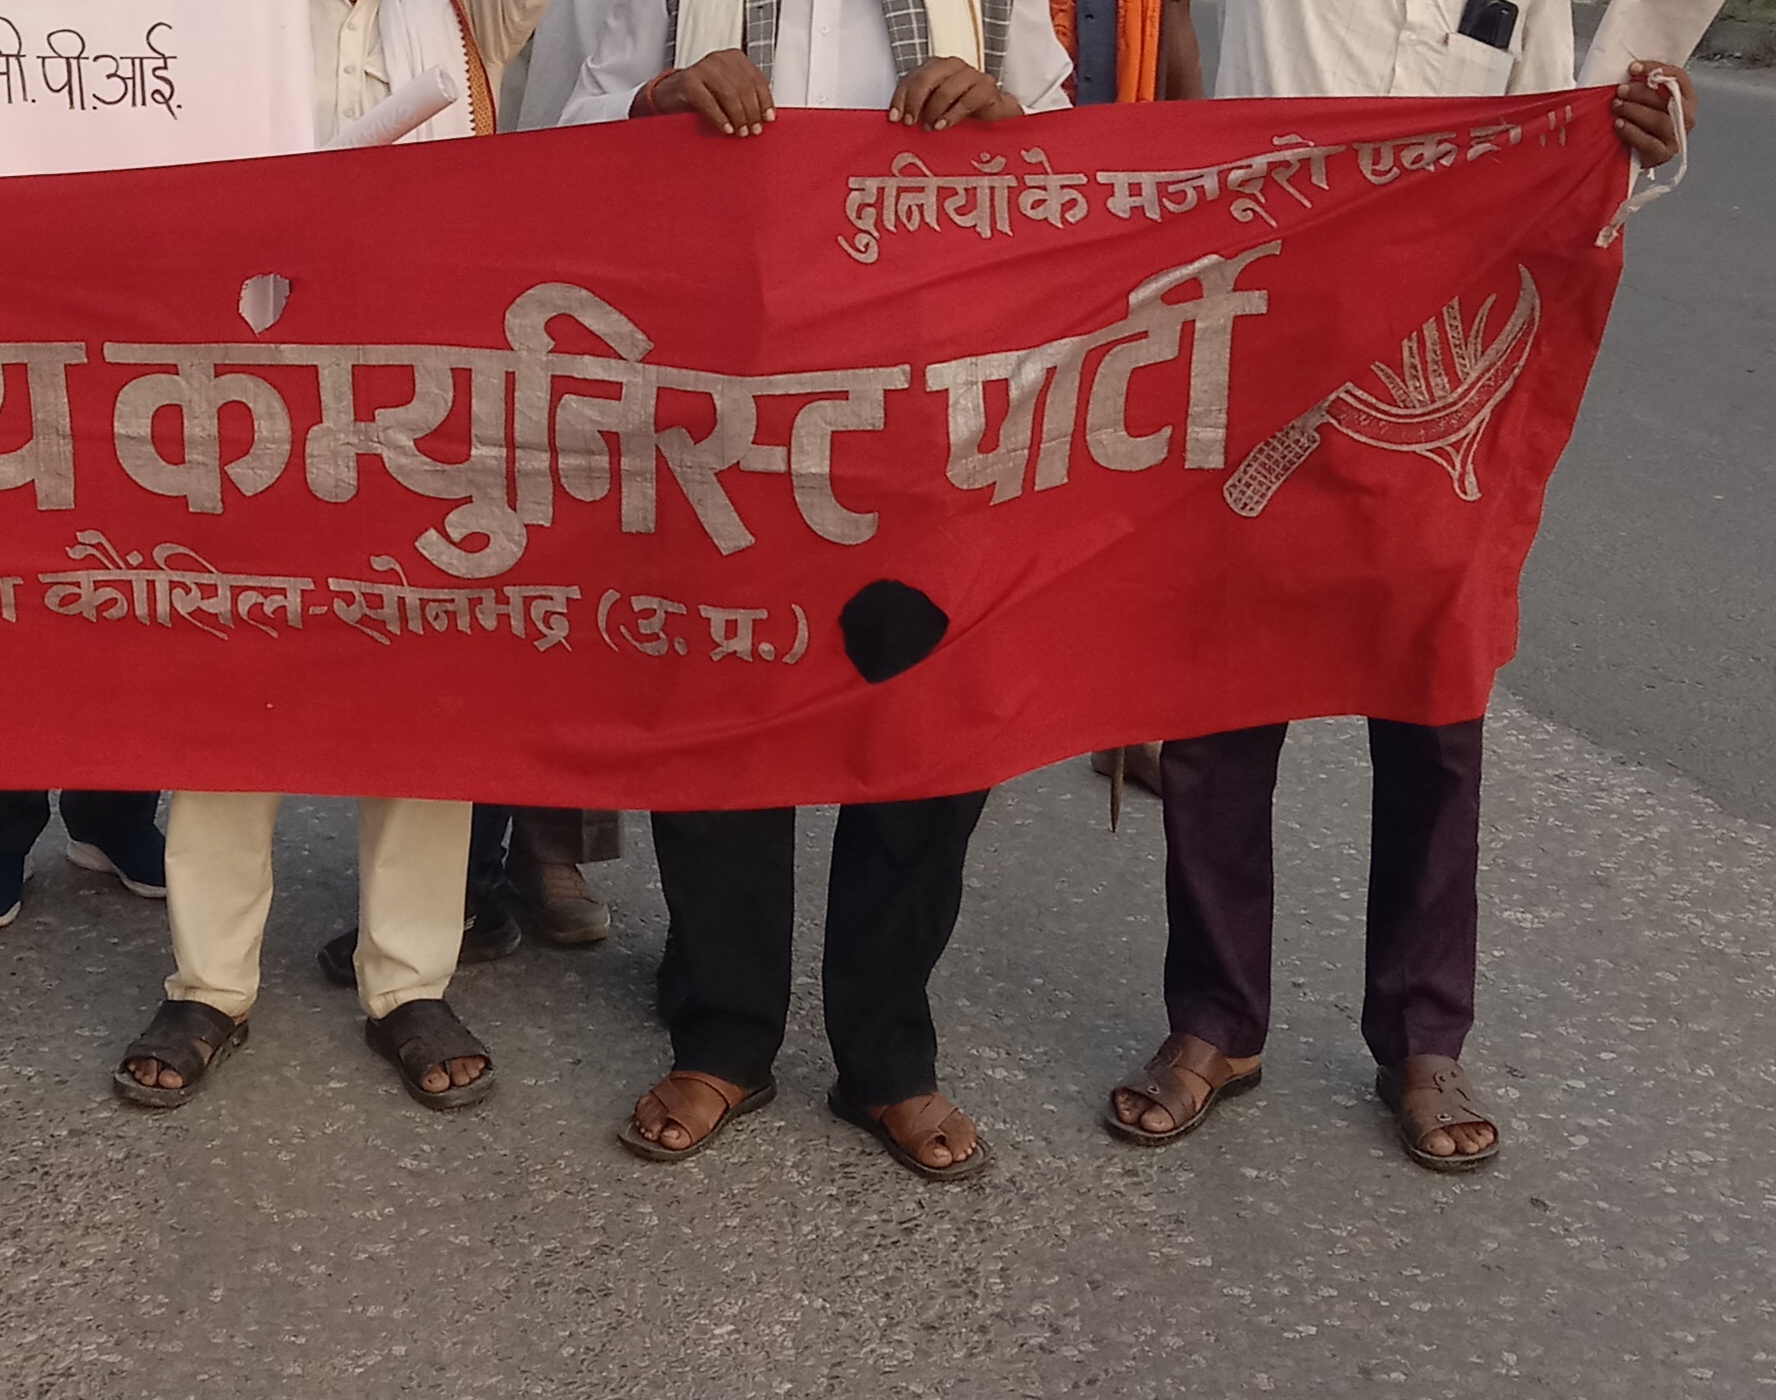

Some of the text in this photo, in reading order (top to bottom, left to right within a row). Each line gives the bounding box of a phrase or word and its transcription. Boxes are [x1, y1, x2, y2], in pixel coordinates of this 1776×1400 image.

[837, 151, 1018, 264] दुनियाँ
[1017, 146, 1089, 229] के
[1353, 131, 1459, 186] एक
[925, 240, 1282, 506] पार्टी
